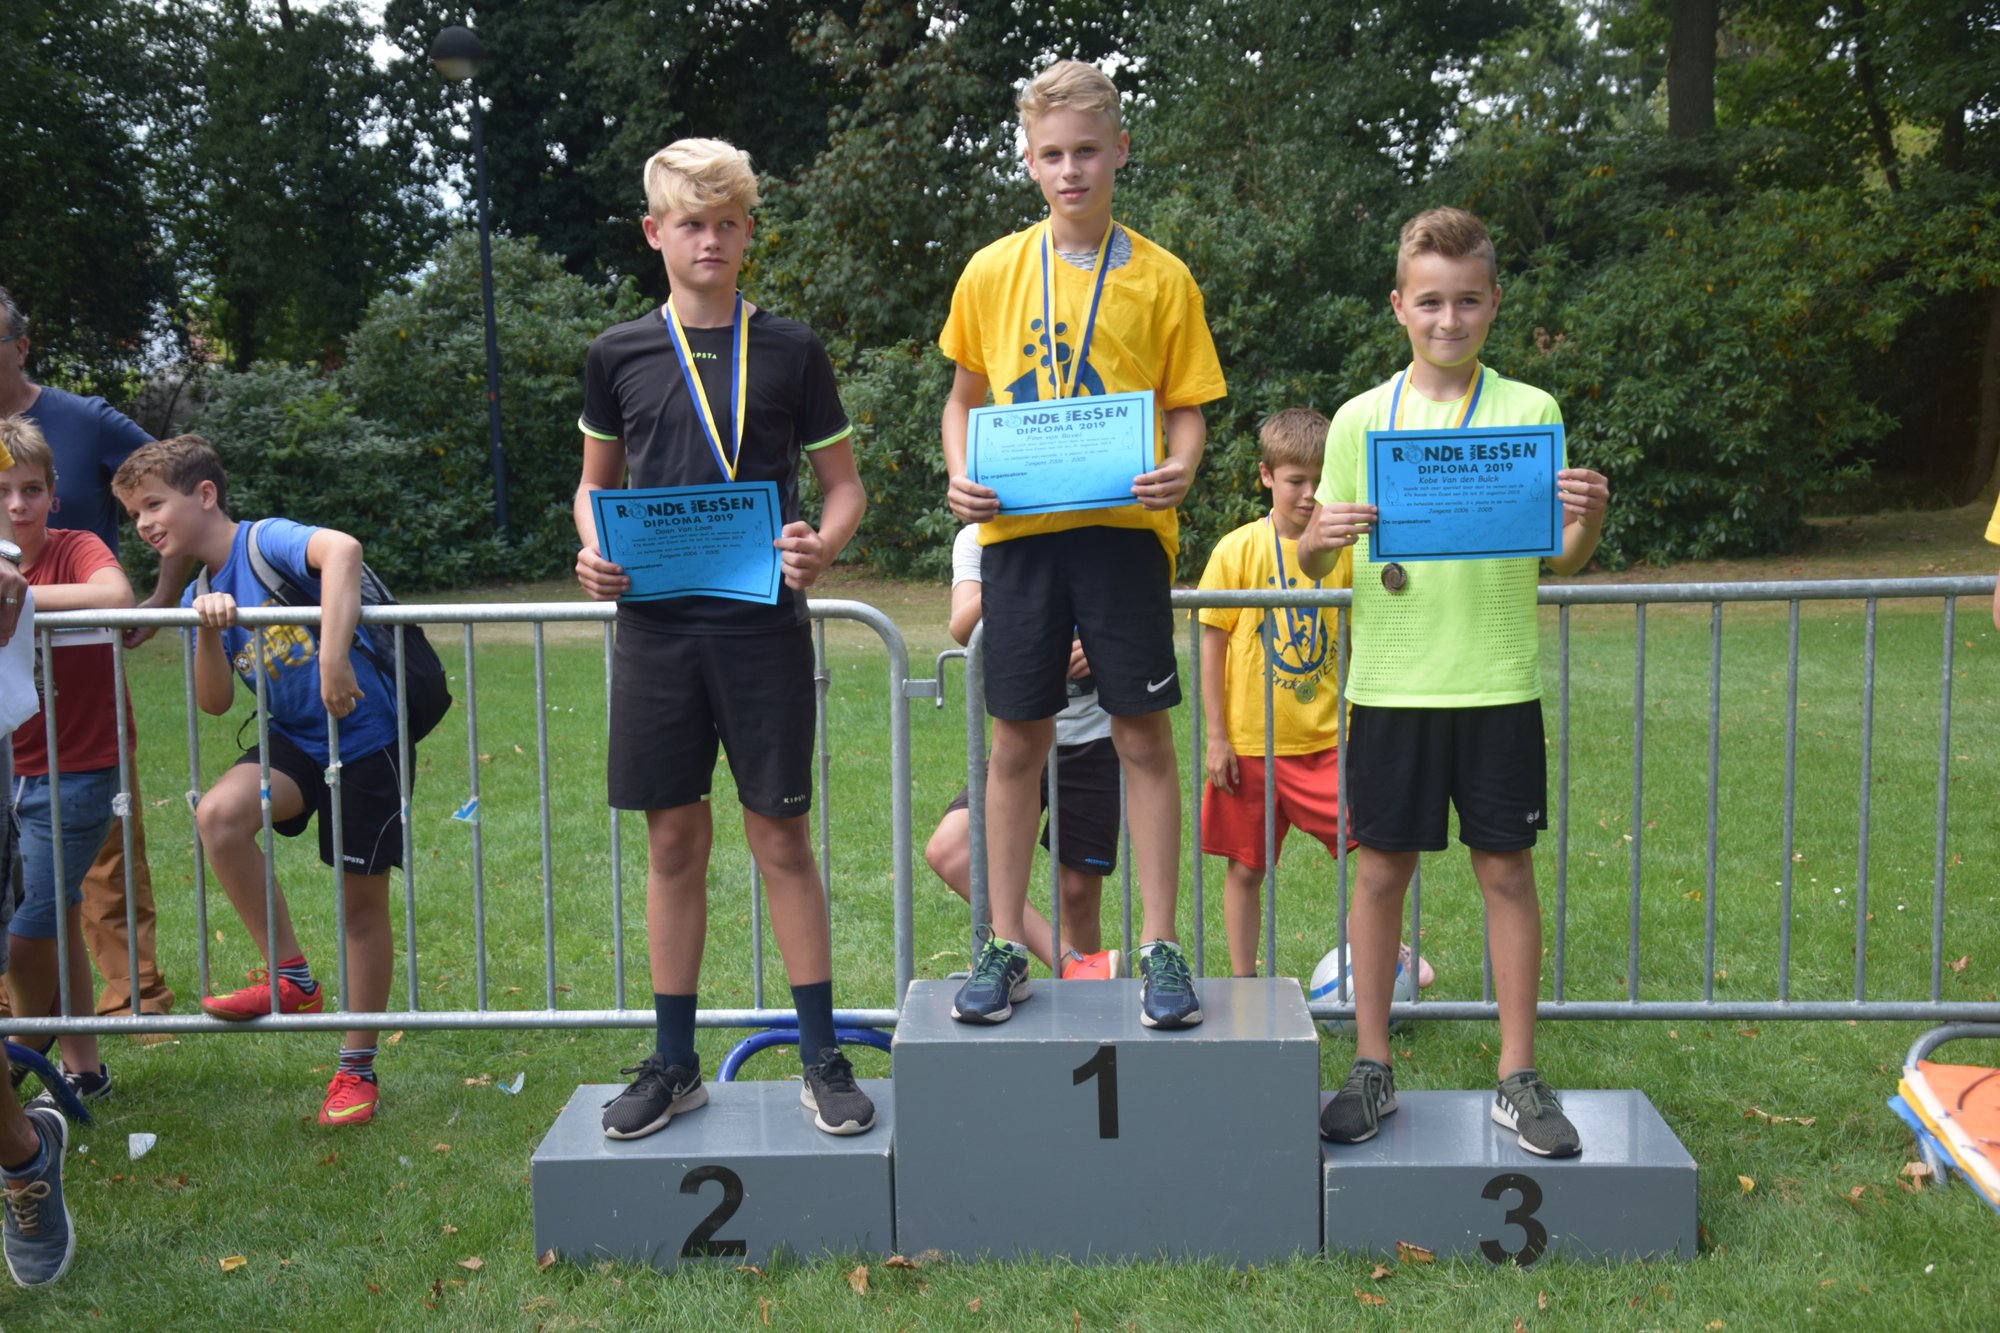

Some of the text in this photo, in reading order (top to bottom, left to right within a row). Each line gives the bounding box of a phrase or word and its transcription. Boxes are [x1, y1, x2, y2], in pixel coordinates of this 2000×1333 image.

[692, 352, 717, 360] IPSTA
[1017, 421, 1106, 435] DIPLOMA 2019
[1418, 462, 1513, 474] DIPLOMA 2019
[643, 513, 734, 528] DIPLOMA 2019
[1073, 1046, 1119, 1139] 1
[679, 1165, 746, 1259] 2
[1480, 1173, 1548, 1268] 3
